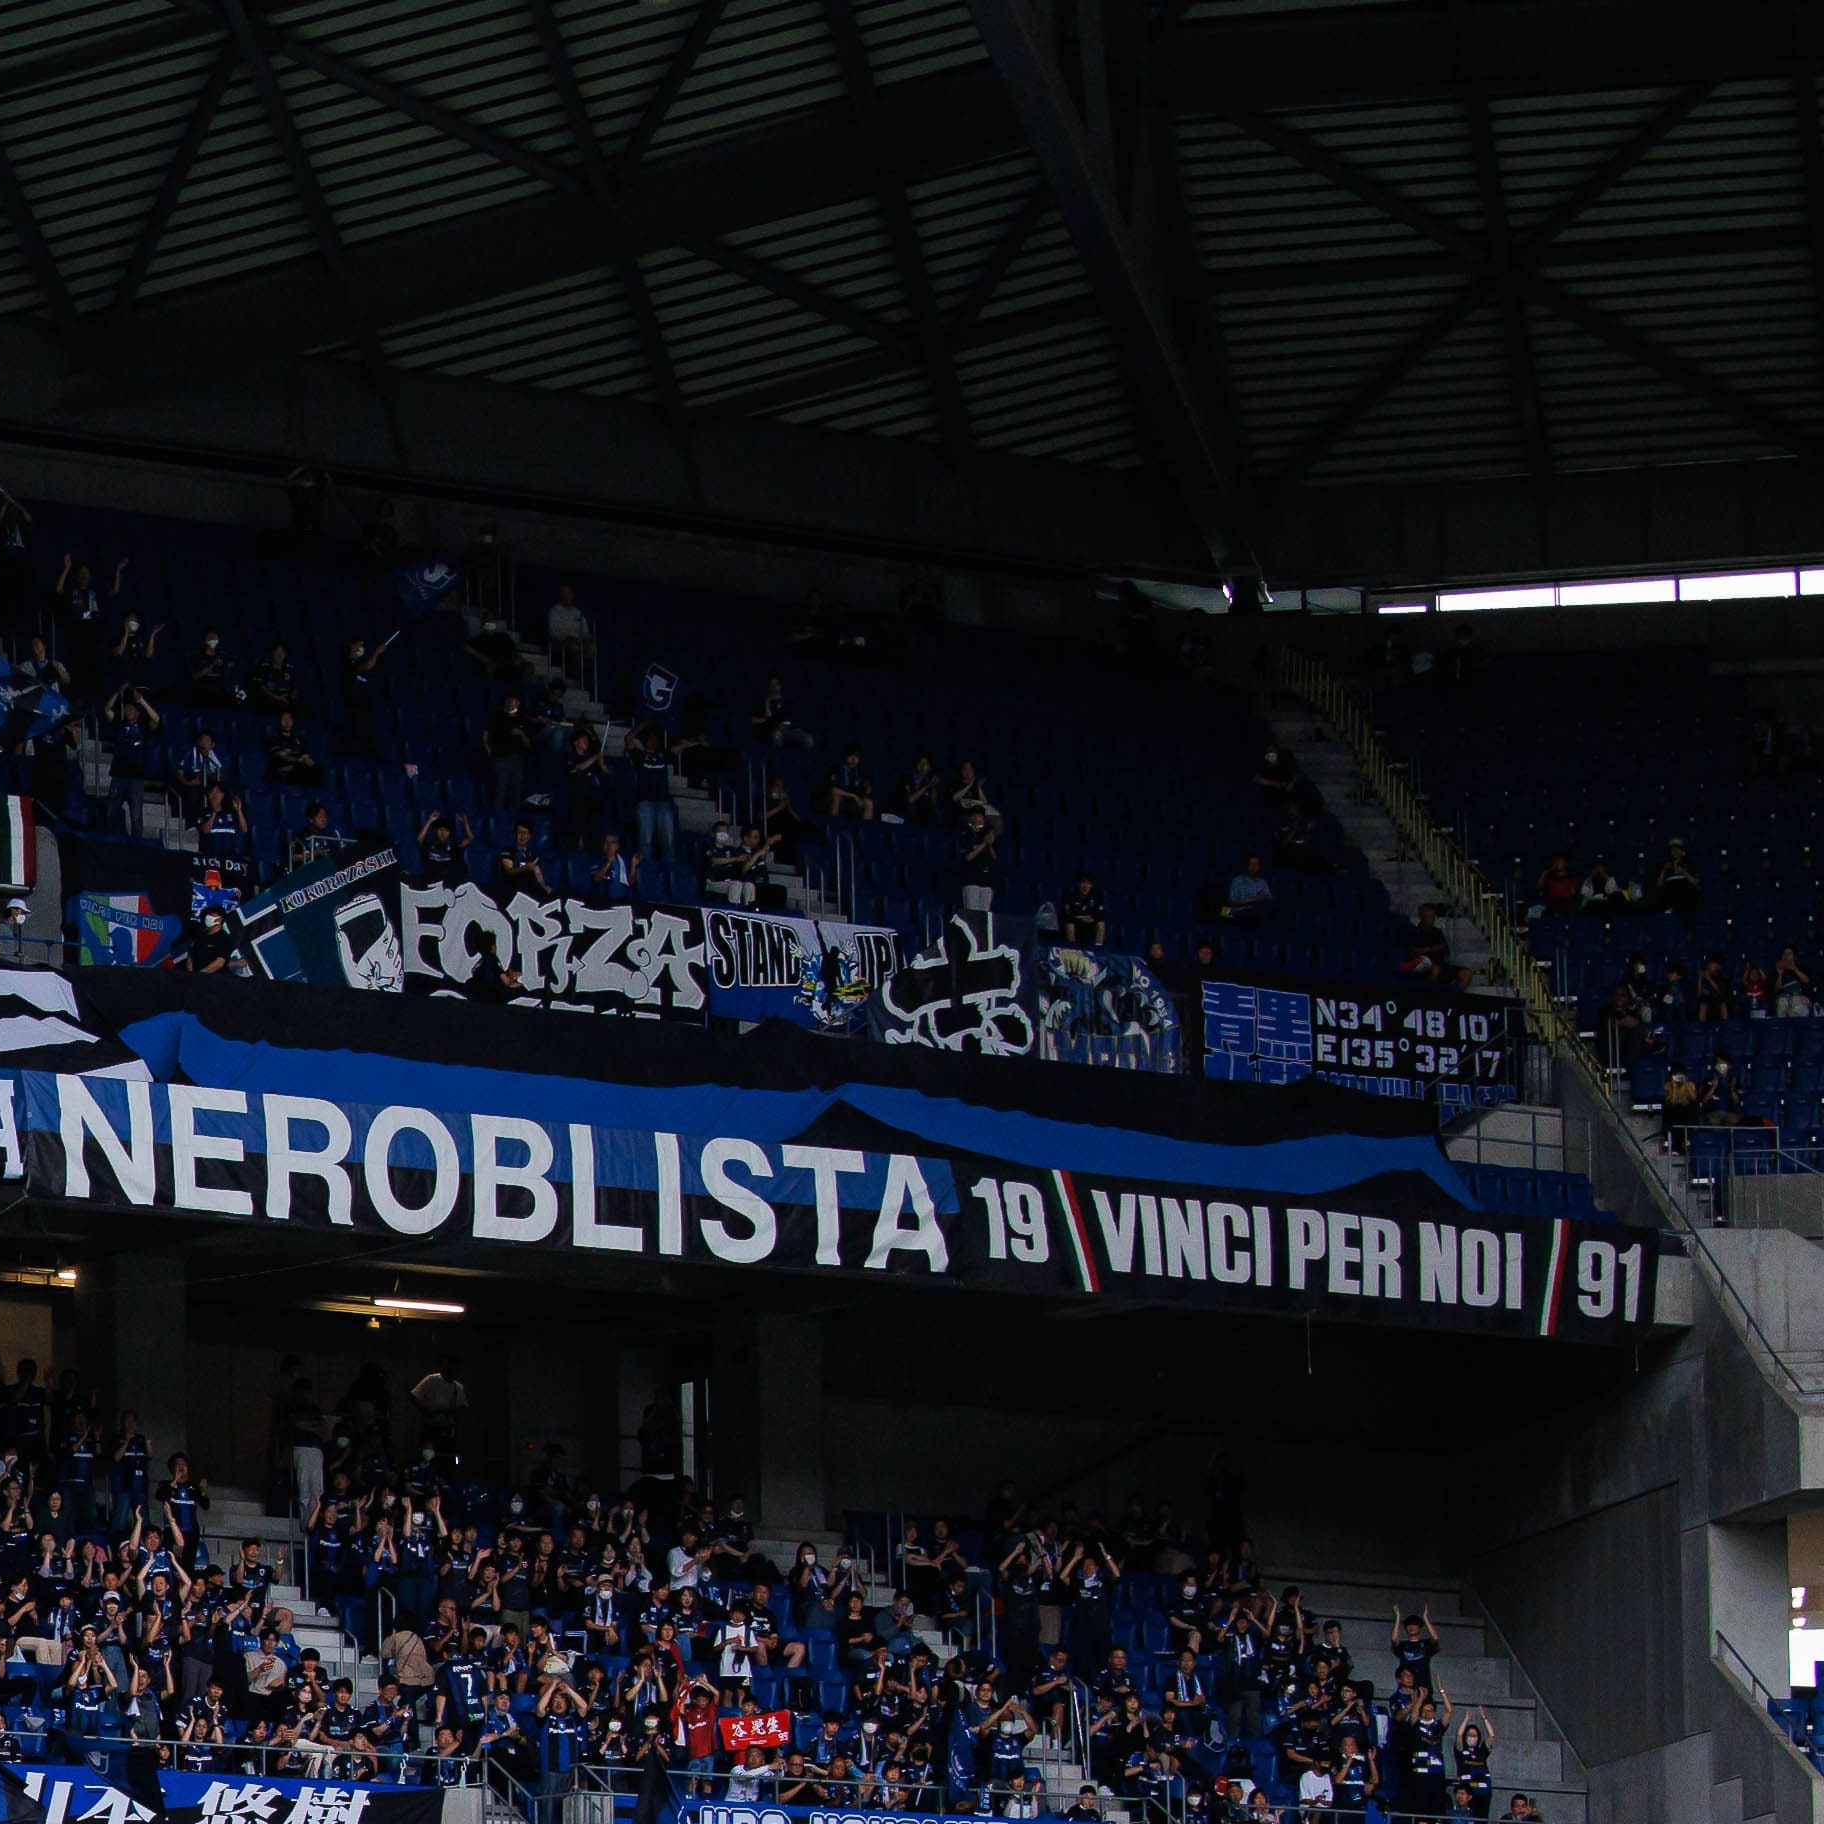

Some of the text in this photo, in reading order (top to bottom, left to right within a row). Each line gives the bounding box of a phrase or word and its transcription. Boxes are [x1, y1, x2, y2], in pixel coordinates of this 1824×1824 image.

[225, 859, 250, 880] Day
[401, 880, 708, 1010] FORZA
[710, 911, 802, 990] STAND
[55, 1072, 952, 1274] NEROBLISTA
[970, 1176, 1642, 1323] 19 VINCI PER NOI 91
